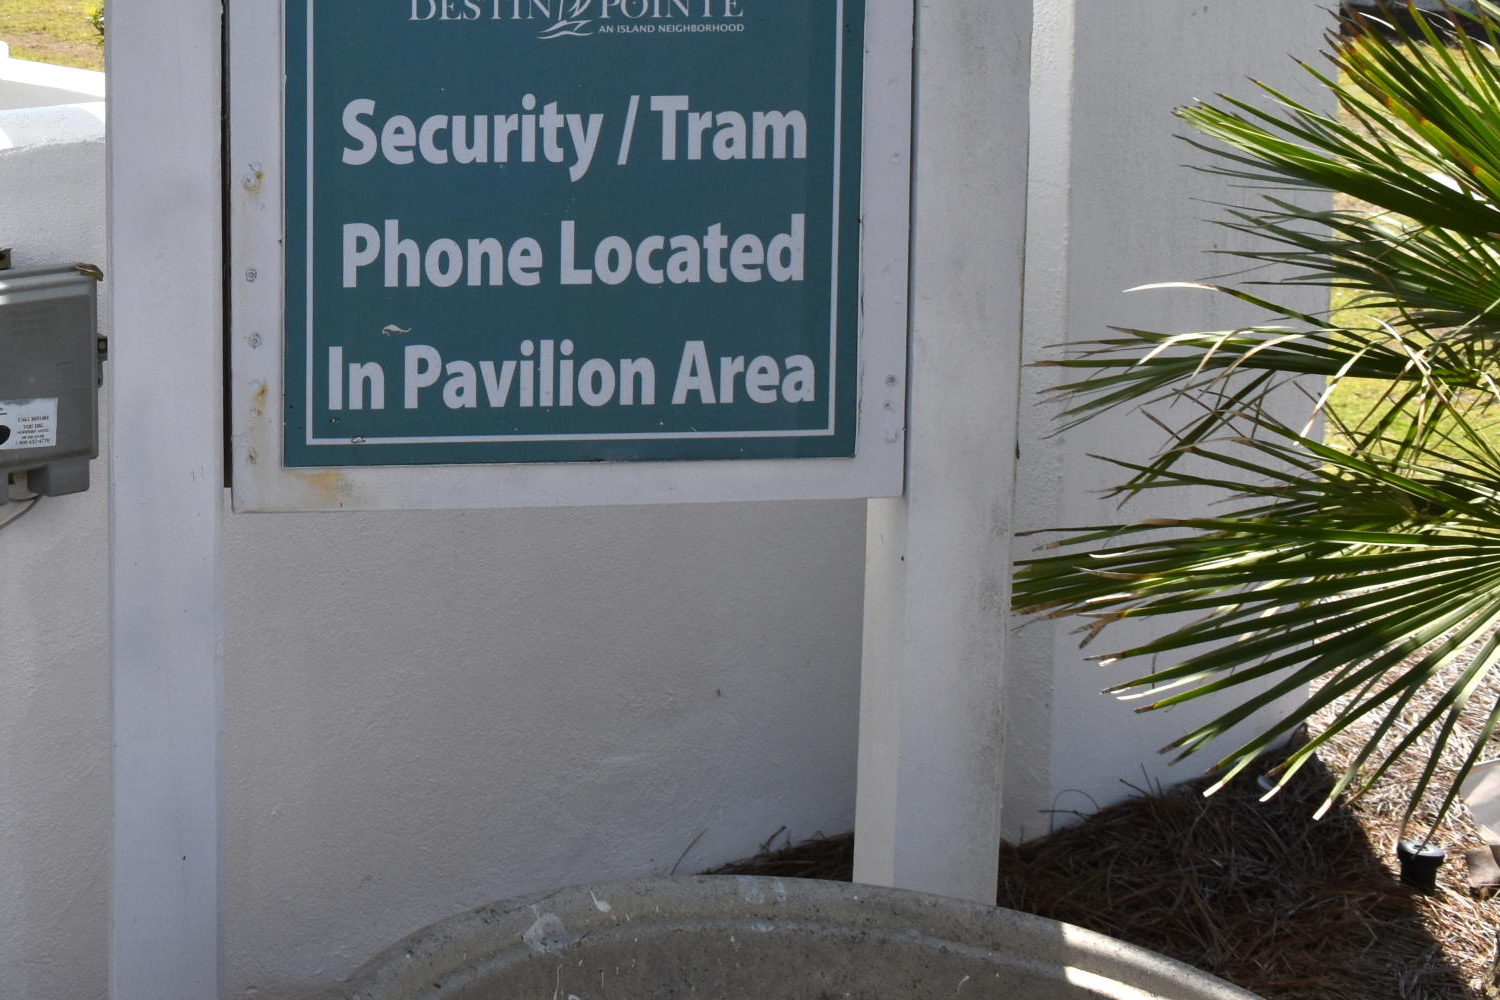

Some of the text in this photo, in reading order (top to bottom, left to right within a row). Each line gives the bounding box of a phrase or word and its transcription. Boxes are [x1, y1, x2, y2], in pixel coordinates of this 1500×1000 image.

[599, 23, 745, 34] AN ISLAND NEIGHBORHOOD
[342, 94, 807, 183] Security / Tram
[342, 213, 805, 288] Phone Located
[328, 339, 815, 411] In Pavilion Area
